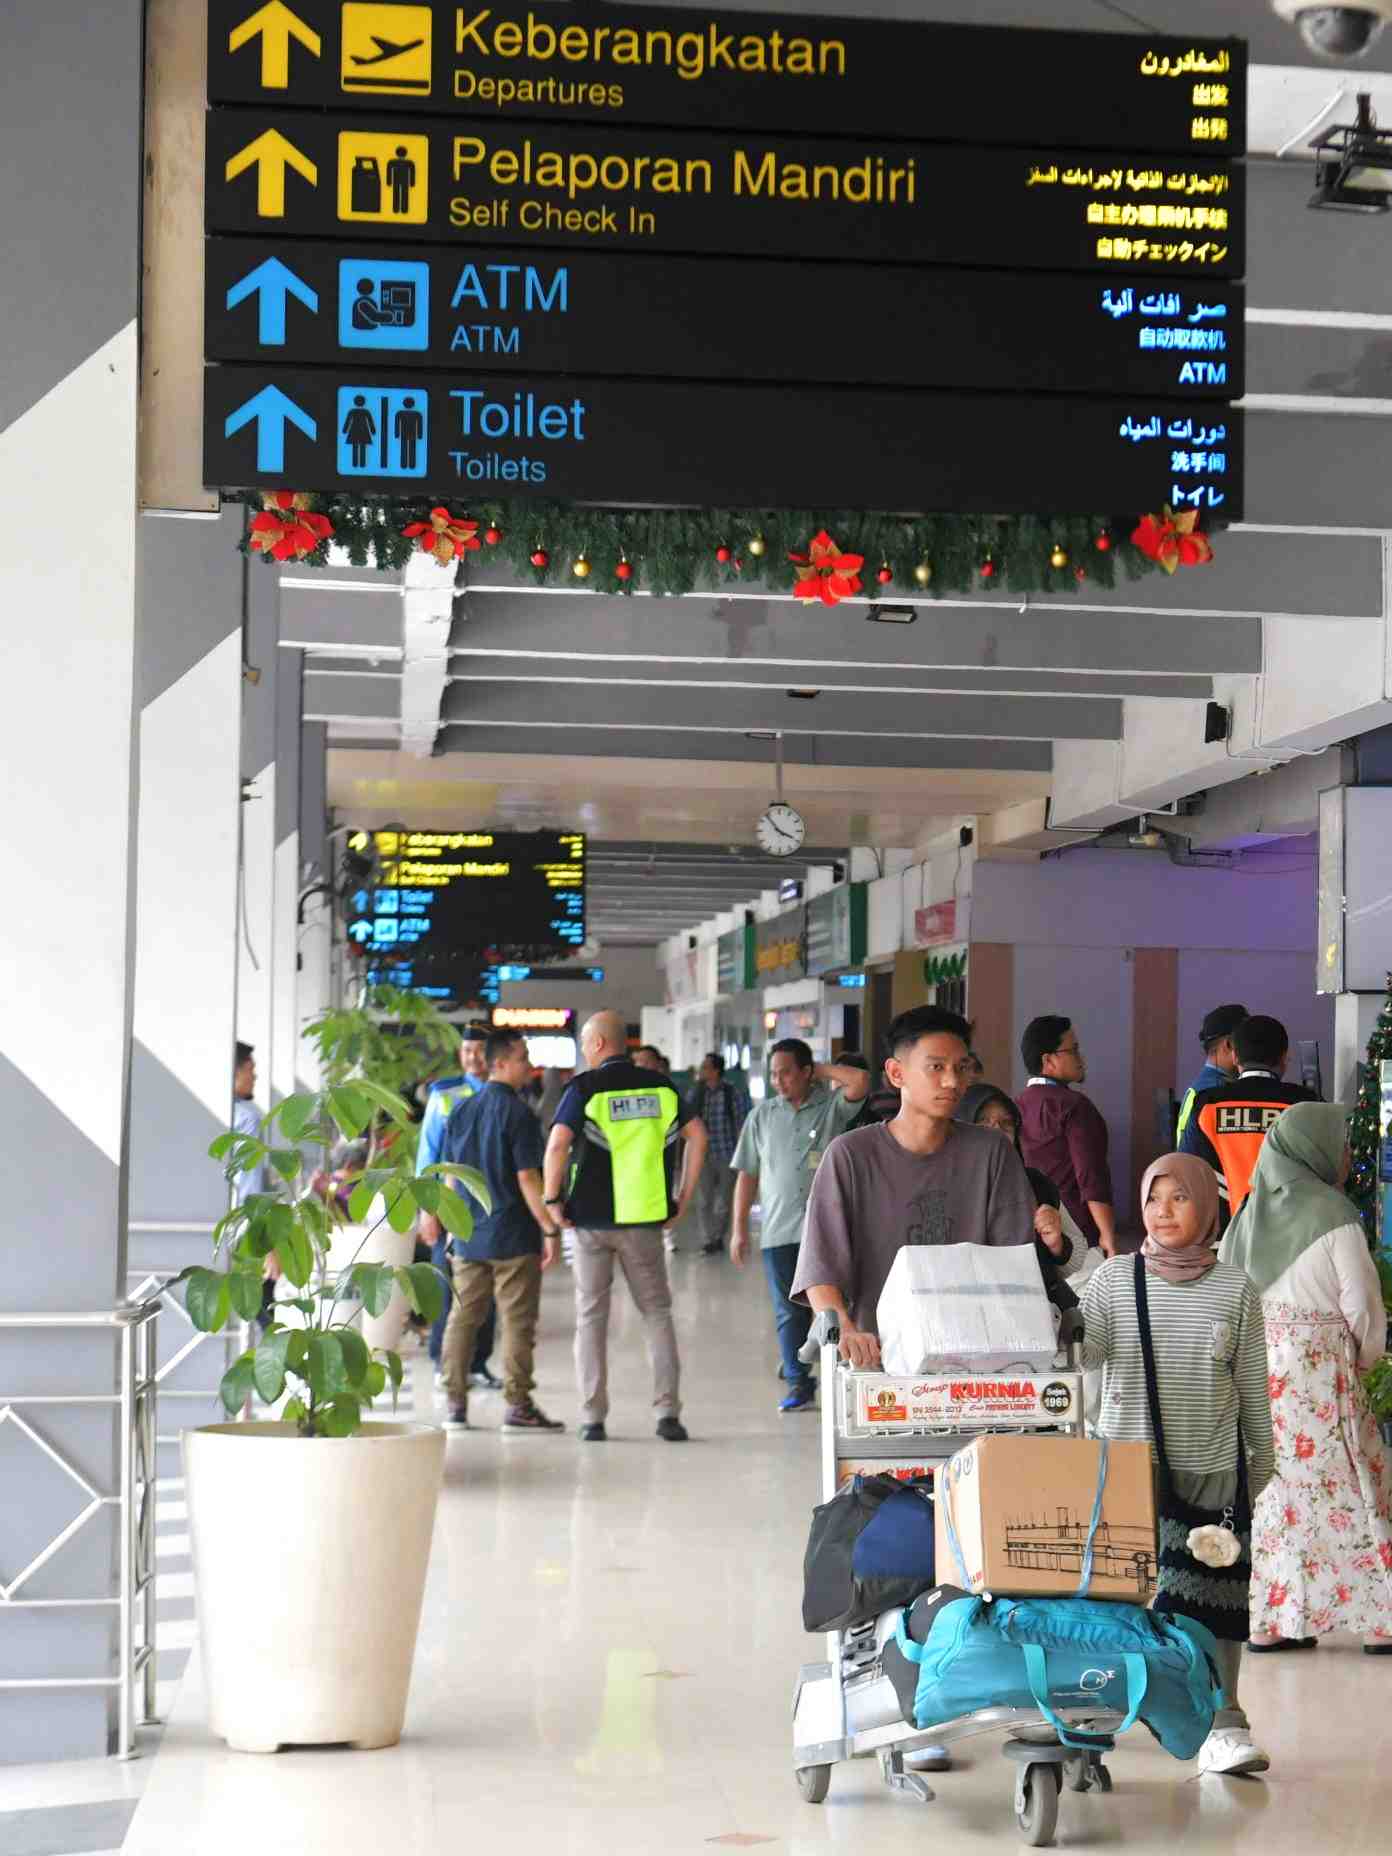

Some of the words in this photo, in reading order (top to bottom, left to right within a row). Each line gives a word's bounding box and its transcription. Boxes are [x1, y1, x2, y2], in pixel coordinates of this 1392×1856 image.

[453, 8, 847, 80] Keberangkatan
[453, 70, 624, 106] Departures
[452, 136, 712, 199] Pelaporan
[733, 151, 916, 203] Mandiri
[449, 198, 508, 226] Self
[519, 202, 617, 233] Check
[630, 207, 656, 233] In
[1096, 237, 1229, 263] 自動チェックイン
[450, 263, 569, 312] ATM
[450, 325, 520, 354] ATM
[1178, 361, 1228, 385] ATM
[449, 390, 586, 441] Toilet
[448, 451, 547, 483] Toilets
[1171, 450, 1227, 474] 洗手间
[1172, 484, 1226, 507] トイレ
[949, 1380, 1036, 1401] KURNIA
[1043, 1396, 1070, 1409] 1969
